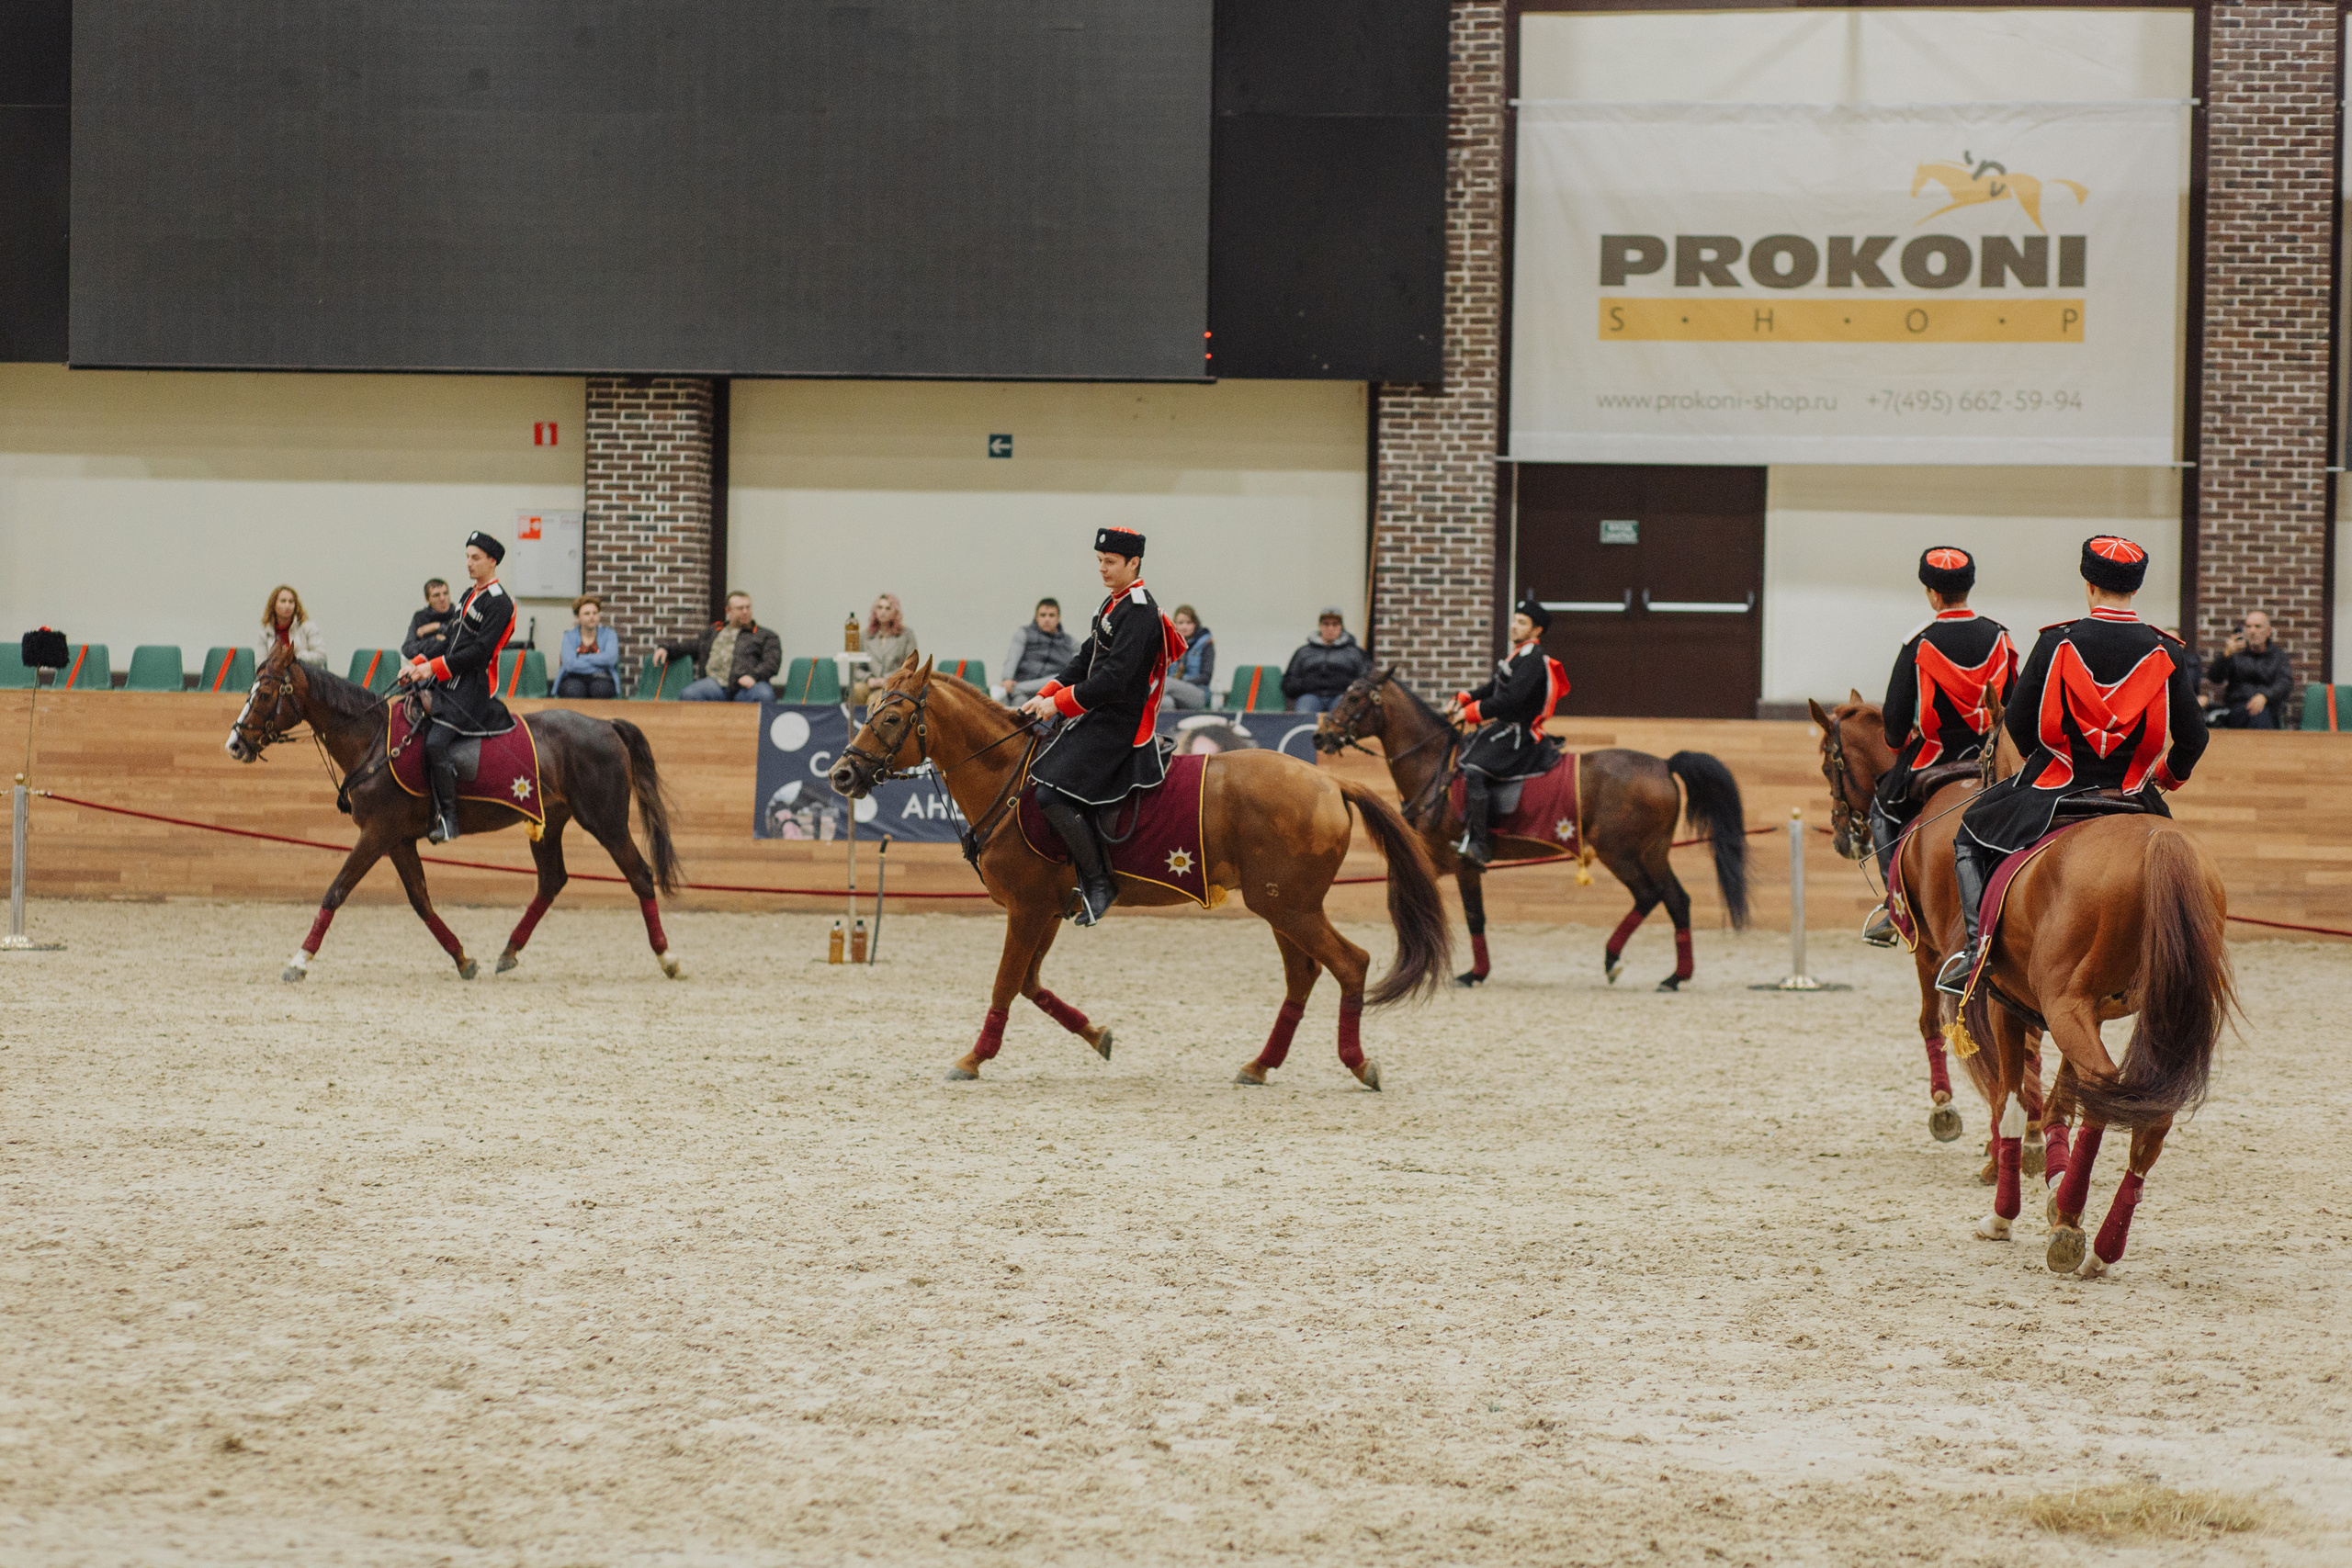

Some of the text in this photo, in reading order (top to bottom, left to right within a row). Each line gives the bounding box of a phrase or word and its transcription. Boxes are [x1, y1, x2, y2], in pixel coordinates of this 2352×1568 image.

[1599, 233, 2087, 289] PROKONI
[1595, 389, 1838, 414] www.prokoni-shop.ru
[1867, 389, 2083, 415] +7(495) 662-59-94
